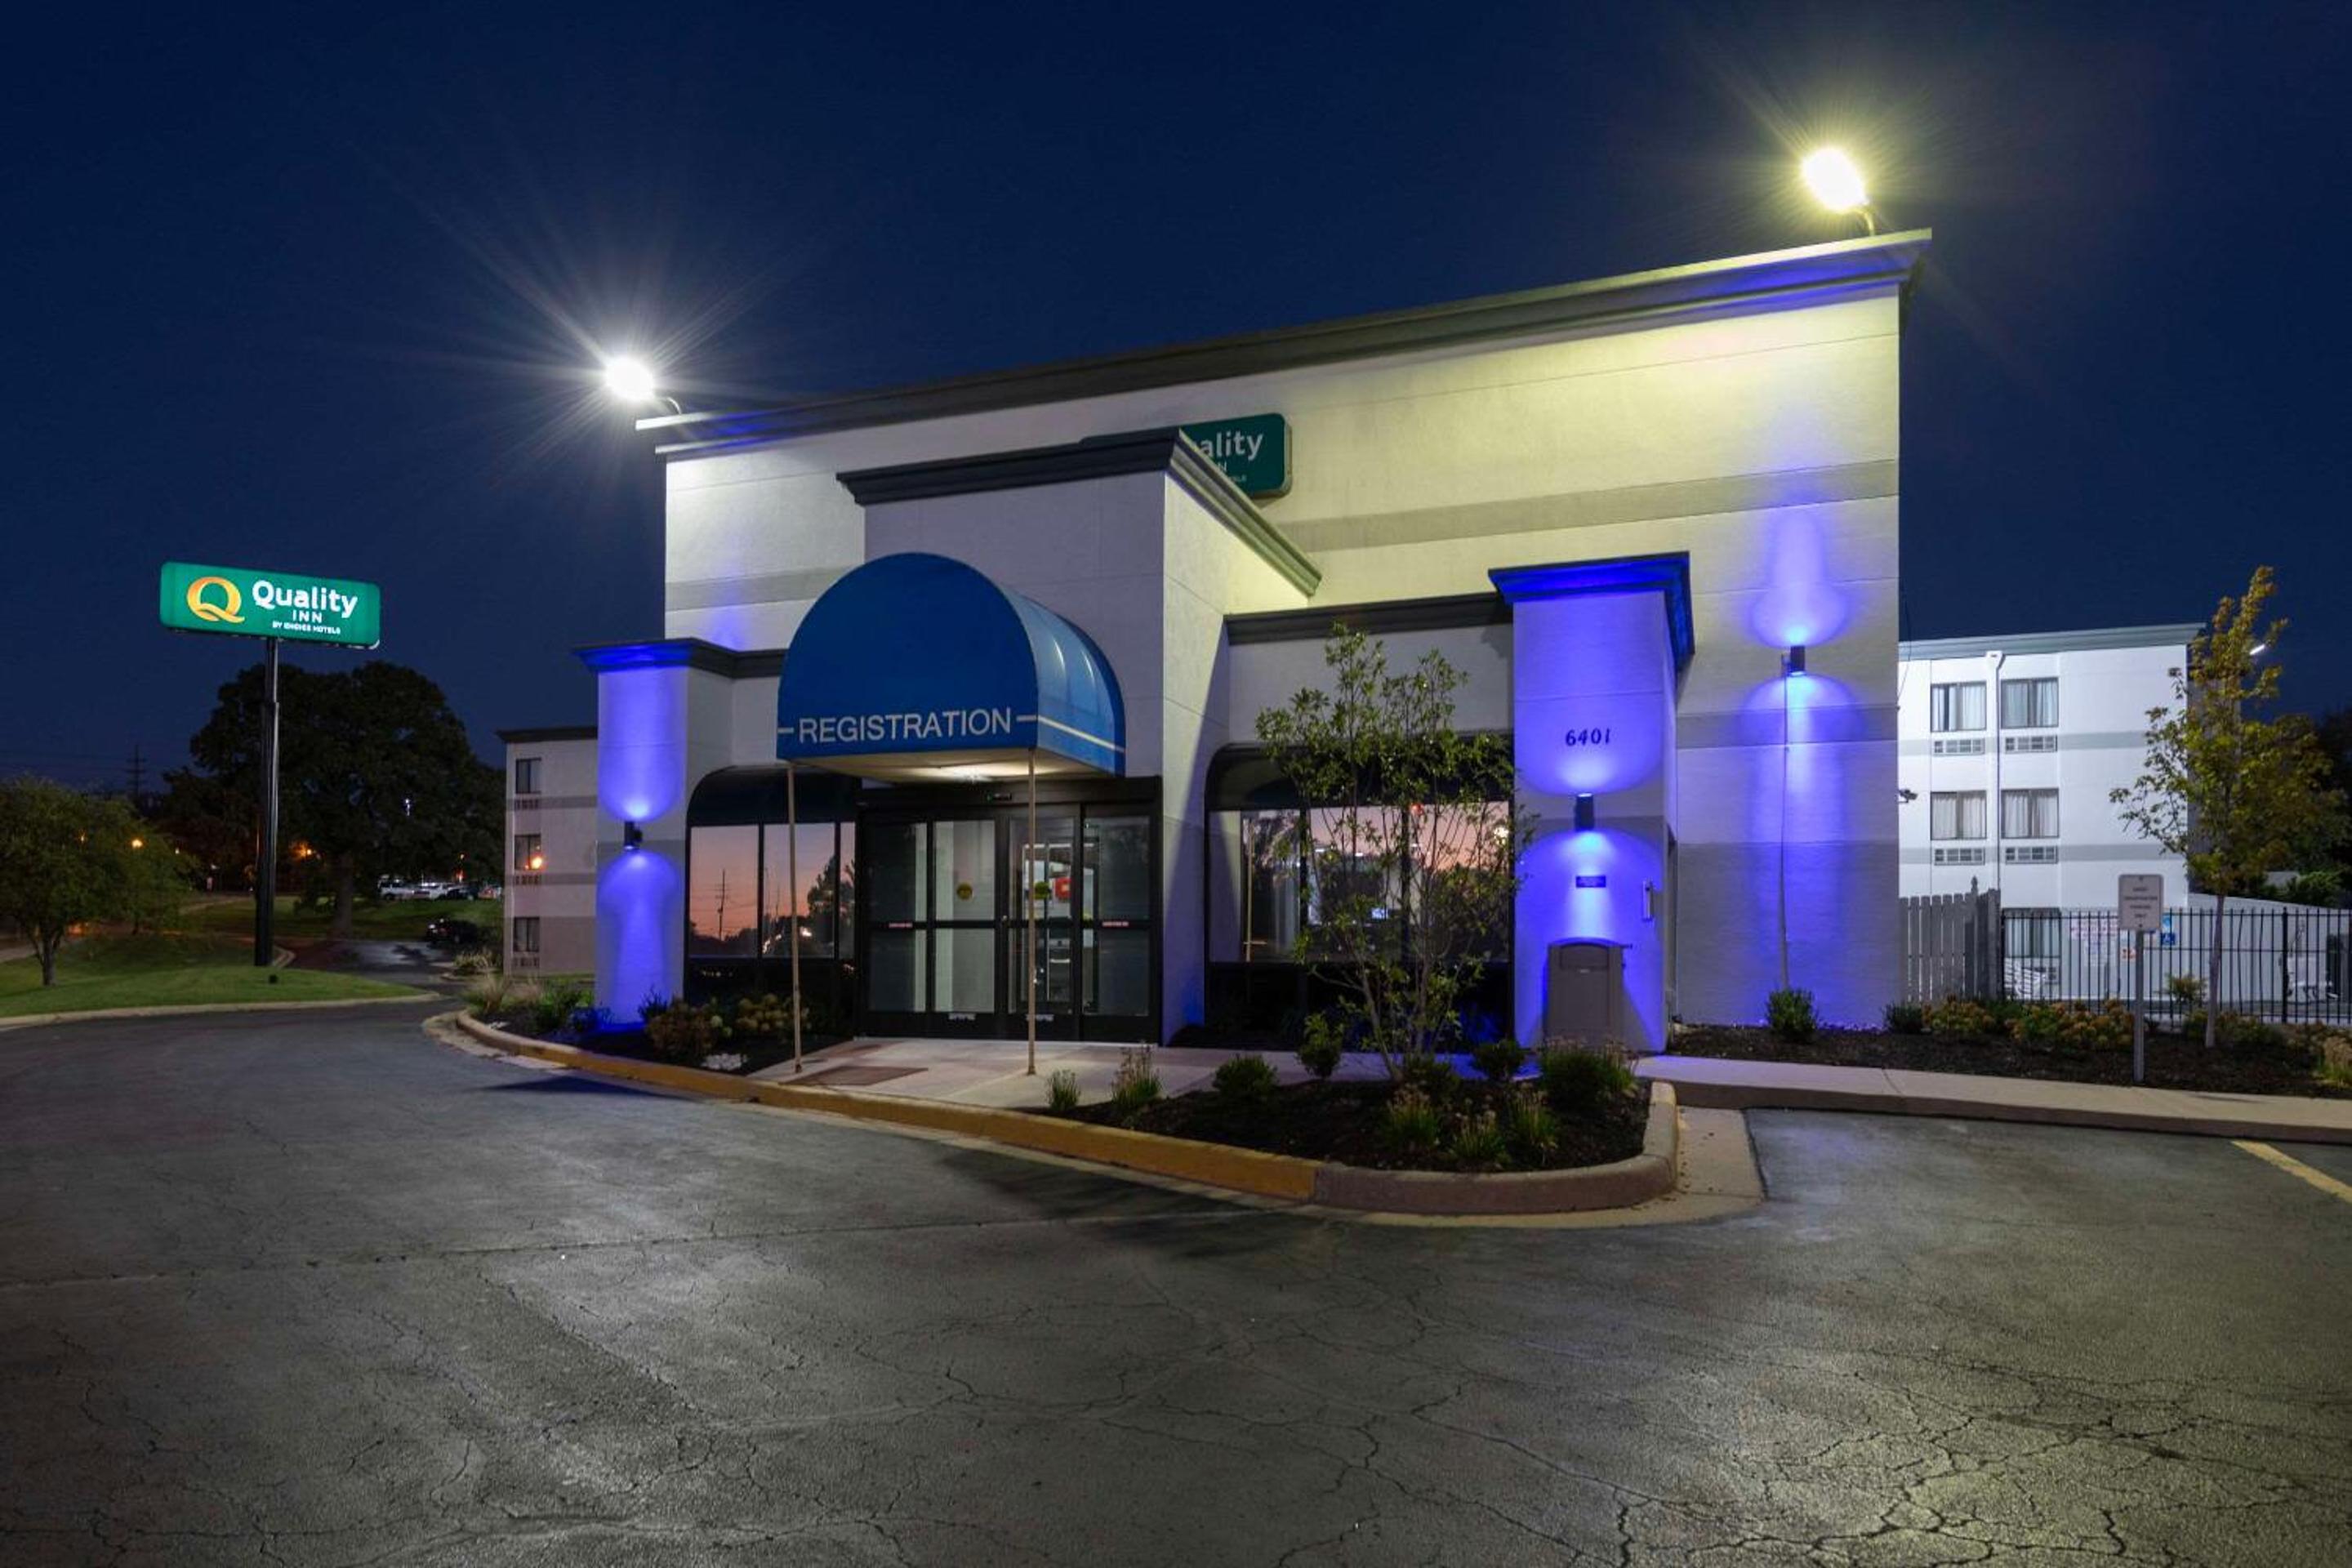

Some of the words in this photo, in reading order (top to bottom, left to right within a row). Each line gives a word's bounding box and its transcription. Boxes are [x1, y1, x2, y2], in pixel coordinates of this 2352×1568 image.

[1193, 430, 1264, 461] ality
[187, 577, 244, 623] Q
[252, 580, 358, 618] Quality
[292, 609, 323, 623] INN
[799, 707, 1010, 744] REGISTRATION
[1565, 728, 1610, 746] 6401
